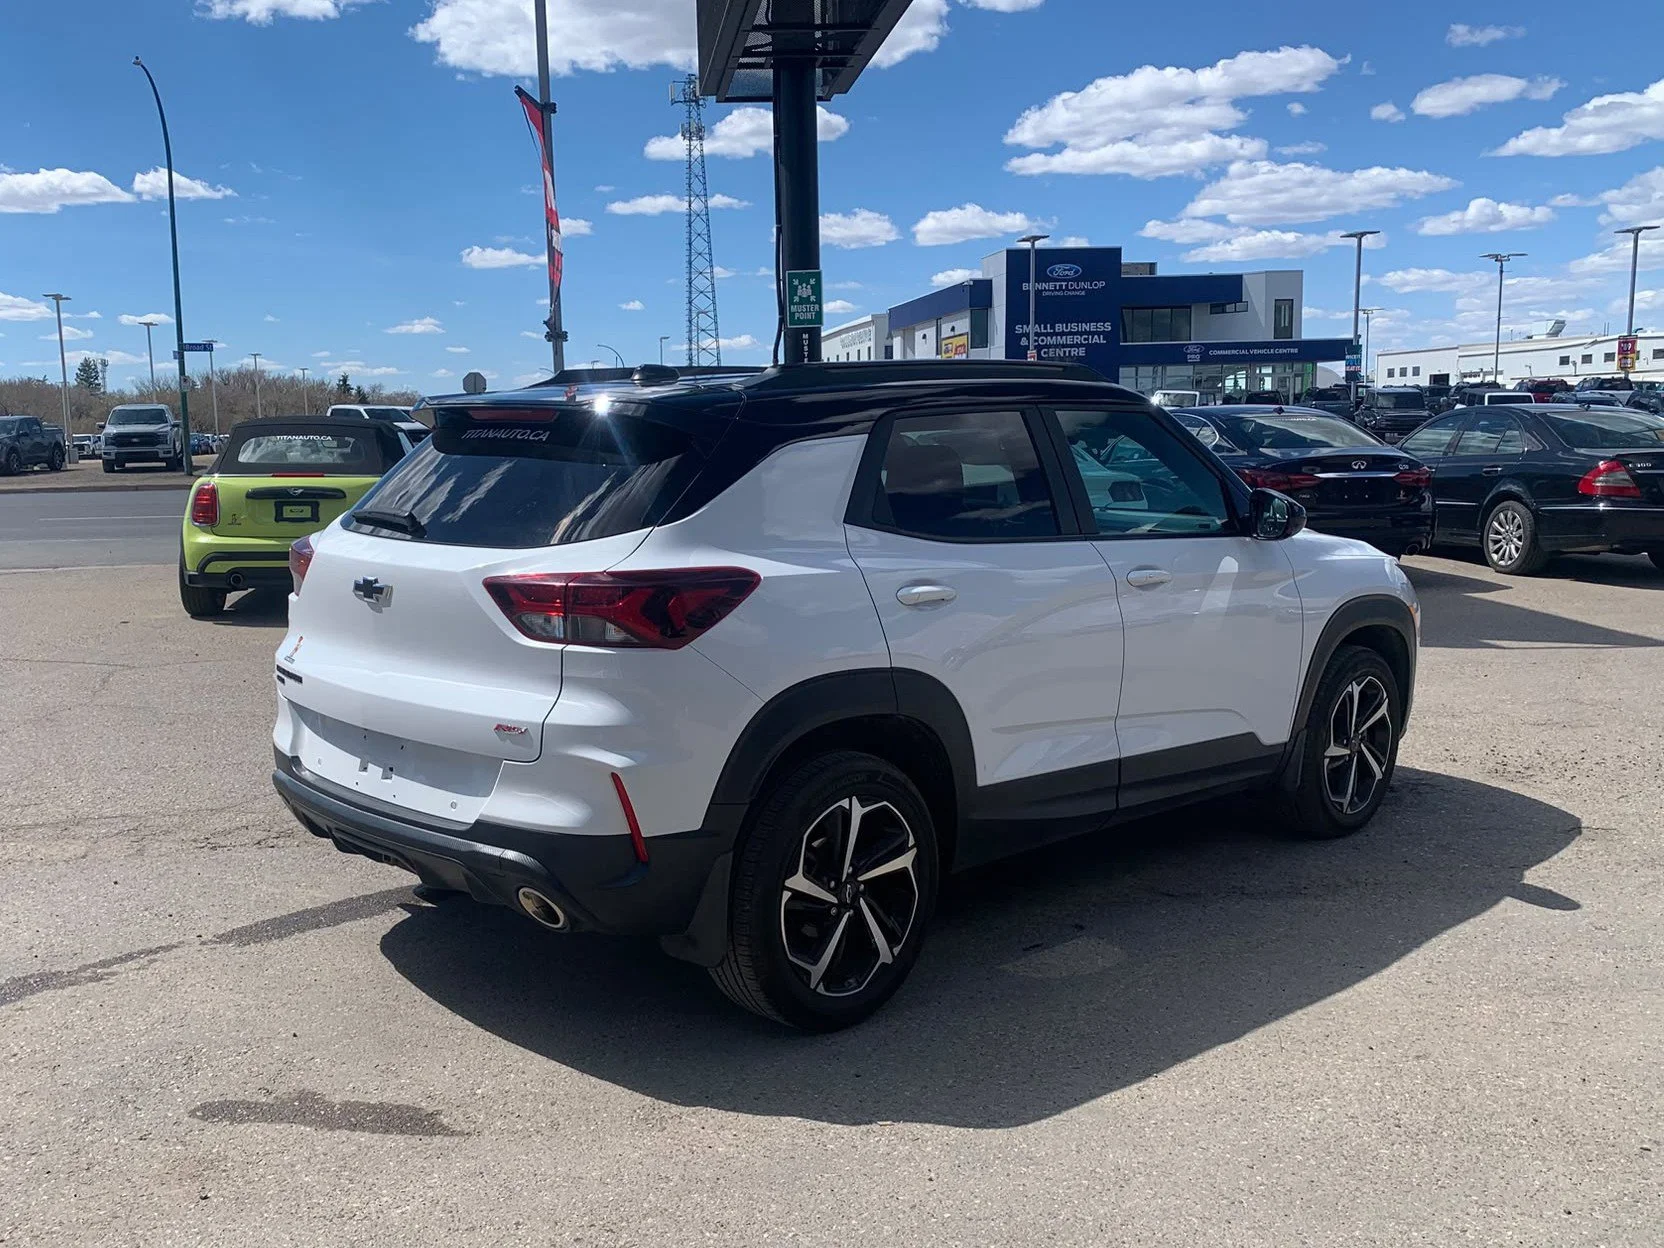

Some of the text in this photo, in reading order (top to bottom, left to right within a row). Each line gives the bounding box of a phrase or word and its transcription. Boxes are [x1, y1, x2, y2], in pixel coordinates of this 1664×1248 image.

[1051, 264, 1077, 277] Ford
[1068, 281, 1106, 289] DUNLOP
[790, 304, 820, 313] MUSTER
[794, 312, 816, 320] POINT
[1055, 322, 1112, 332] BUSINESS
[1020, 336, 1029, 346] &
[1040, 347, 1086, 357] CENTRE
